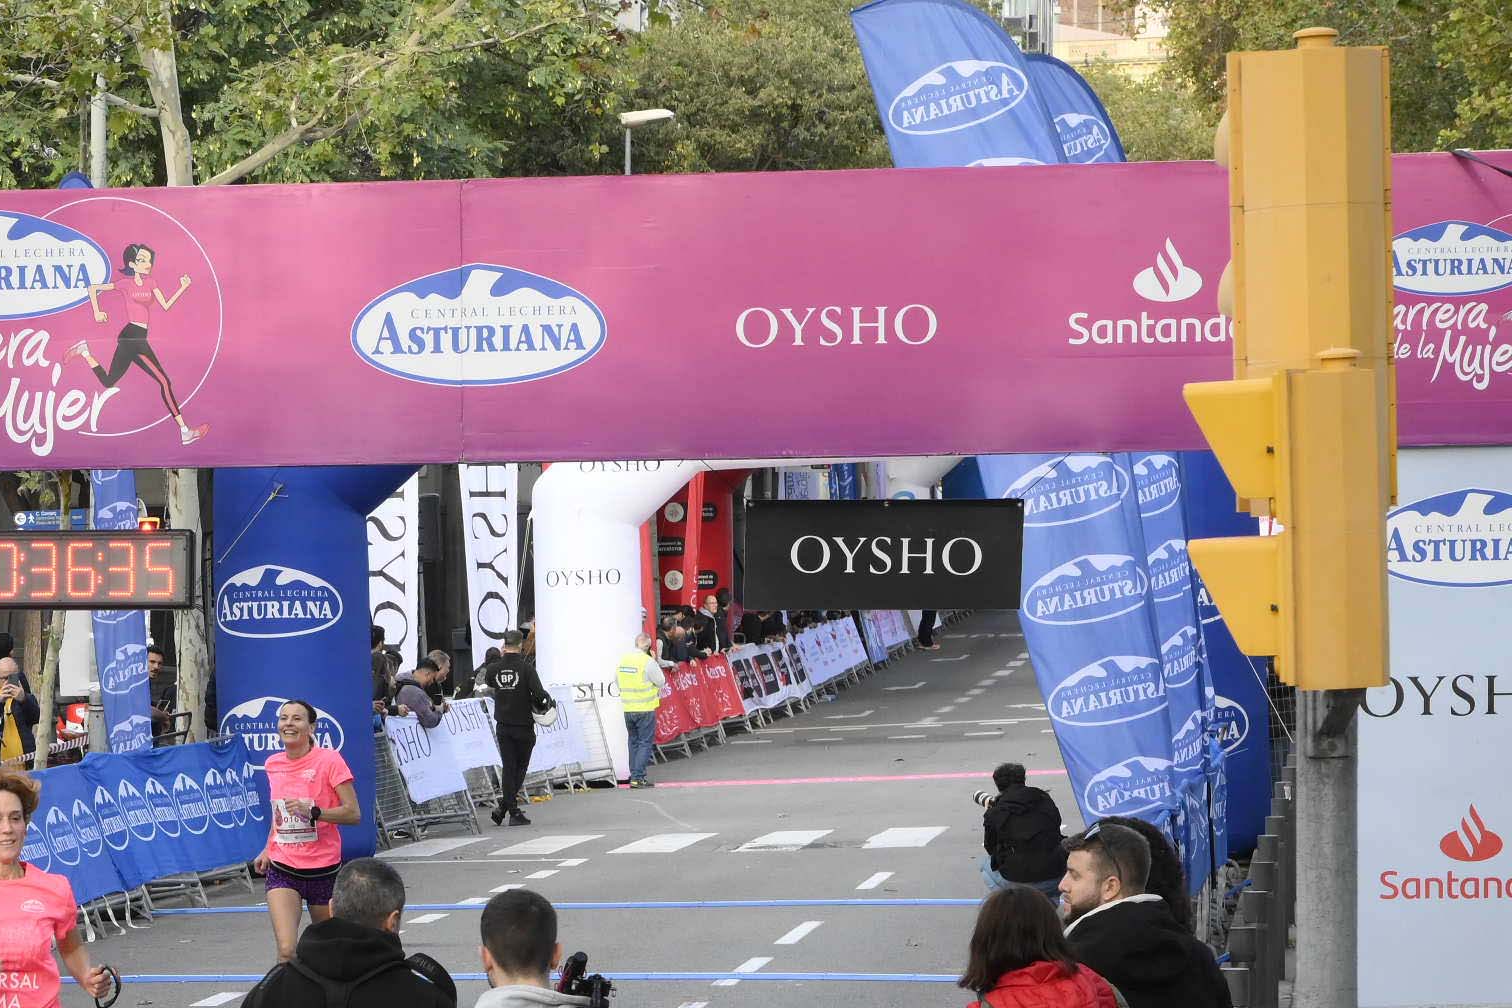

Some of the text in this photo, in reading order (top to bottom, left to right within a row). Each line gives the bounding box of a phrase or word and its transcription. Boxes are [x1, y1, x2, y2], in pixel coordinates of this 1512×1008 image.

[13, 247, 86, 259] LECHERA
[1408, 245, 1512, 255] CENTRAL LECHER
[410, 304, 578, 318] CENTRAL LECHERA
[1393, 301, 1489, 331] arrera
[372, 311, 586, 356] ASTURIANA
[735, 303, 938, 349] OYSHO
[1417, 331, 1435, 359] la
[1414, 524, 1482, 534] CENTRAL
[1387, 527, 1512, 564] ASTURI
[790, 535, 983, 577] OYSHO
[546, 568, 621, 587] OYSHO
[233, 589, 328, 599] CENTRAL LECHERA
[221, 595, 333, 622] ASTURIANA
[501, 674, 514, 683] BP
[235, 722, 275, 730] CENTRAL
